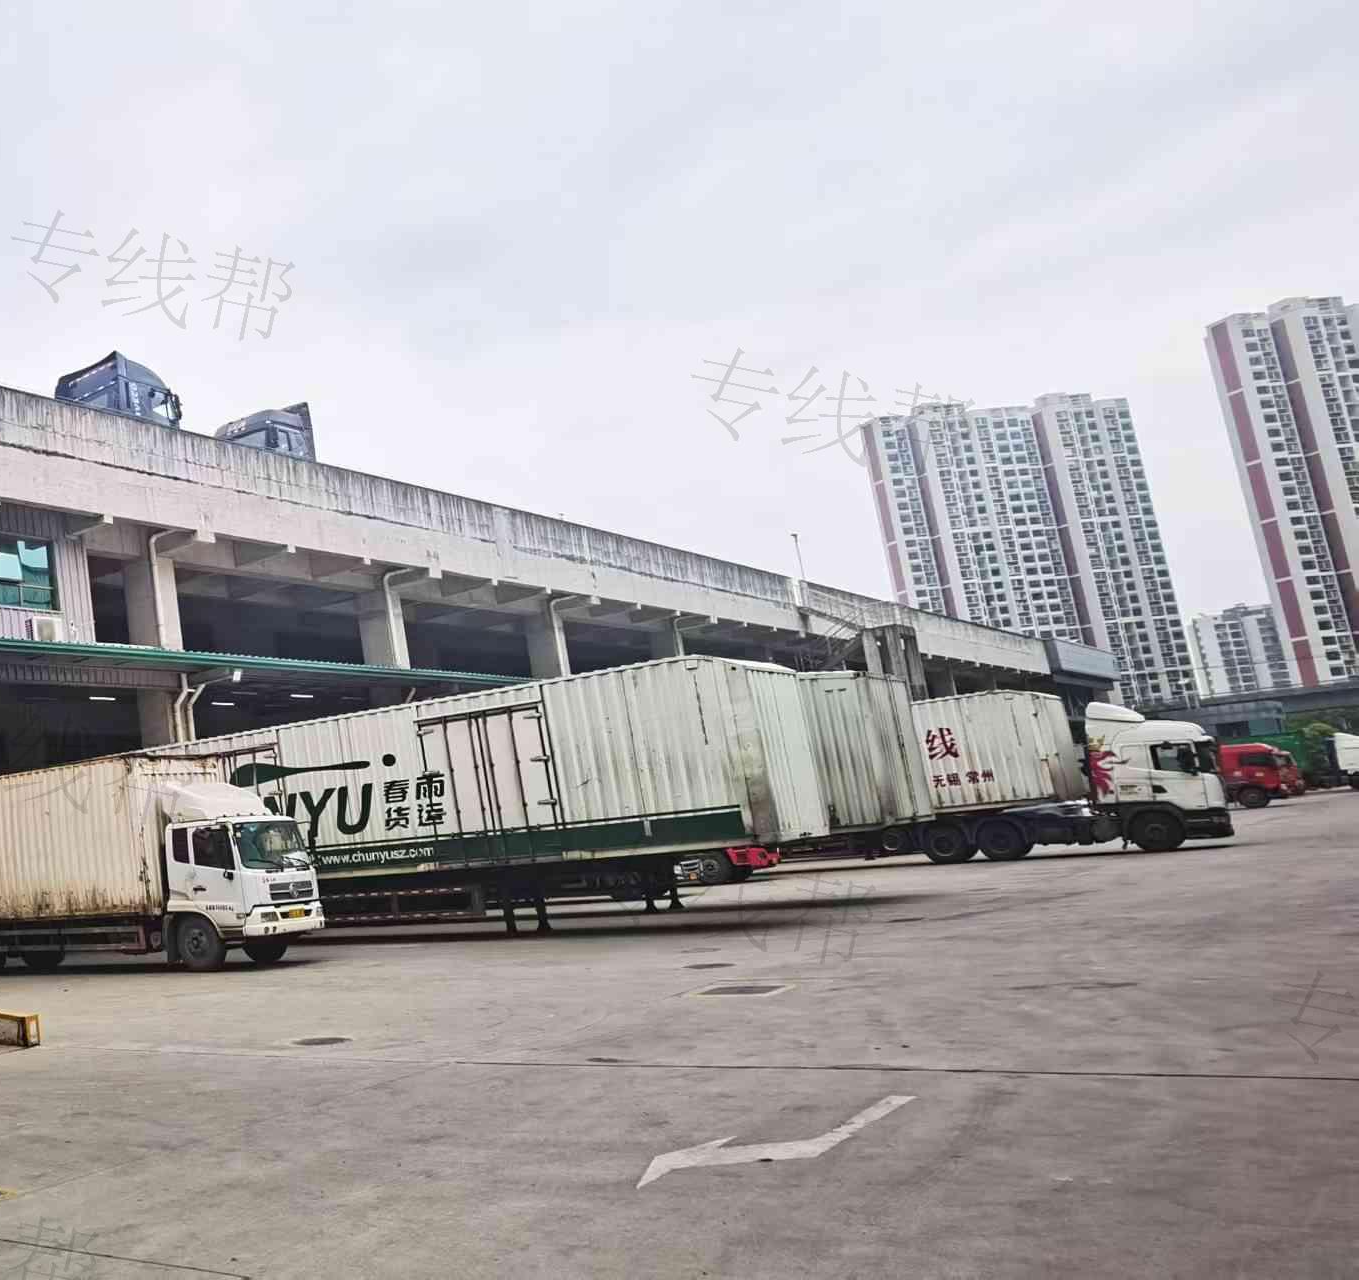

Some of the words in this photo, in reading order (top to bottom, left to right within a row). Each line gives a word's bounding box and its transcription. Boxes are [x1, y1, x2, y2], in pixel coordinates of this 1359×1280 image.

[925, 727, 960, 760] 线
[383, 771, 446, 804] 春雨
[384, 802, 447, 832] 货运
